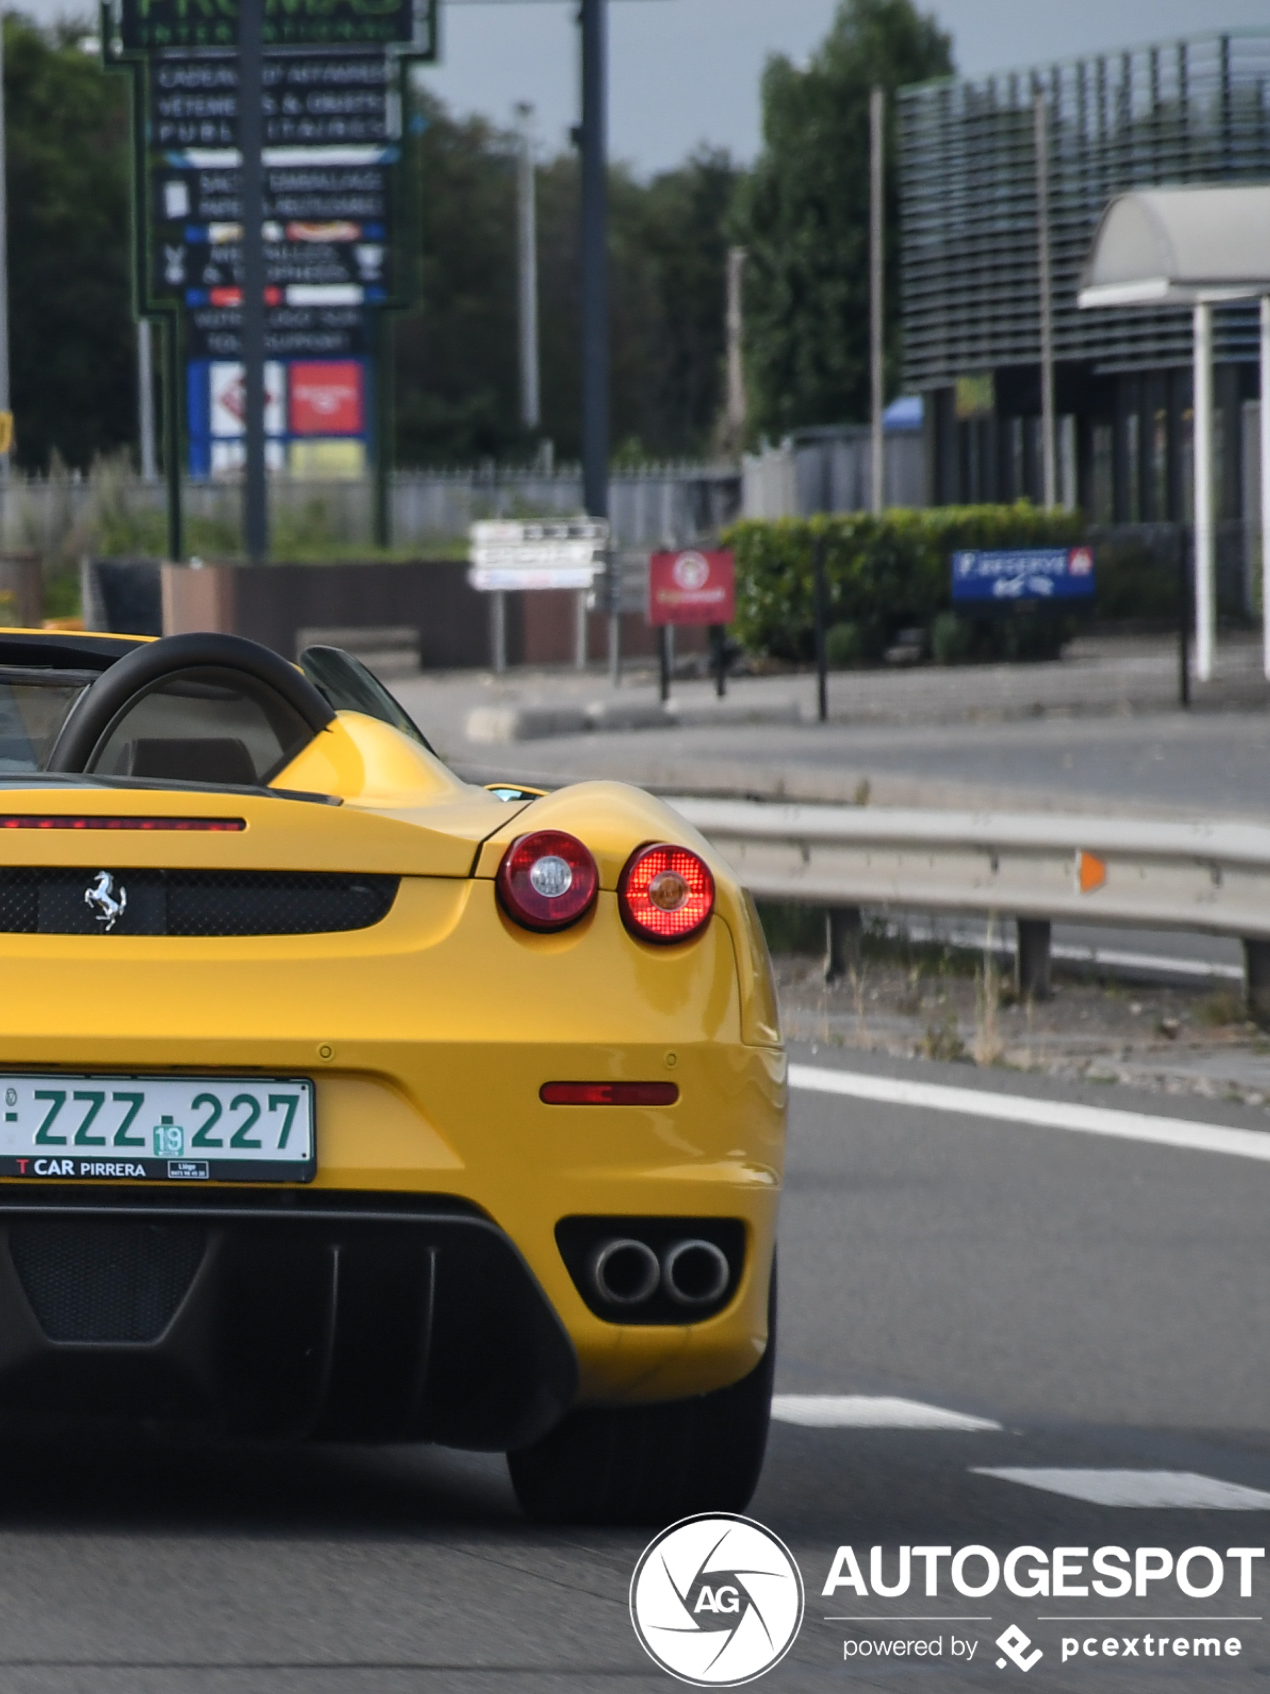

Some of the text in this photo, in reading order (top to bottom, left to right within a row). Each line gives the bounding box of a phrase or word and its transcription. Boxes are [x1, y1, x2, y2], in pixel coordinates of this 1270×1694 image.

[155, 1127, 182, 1151] 19
[16, 1159, 146, 1177] T CAR PIRRERA
